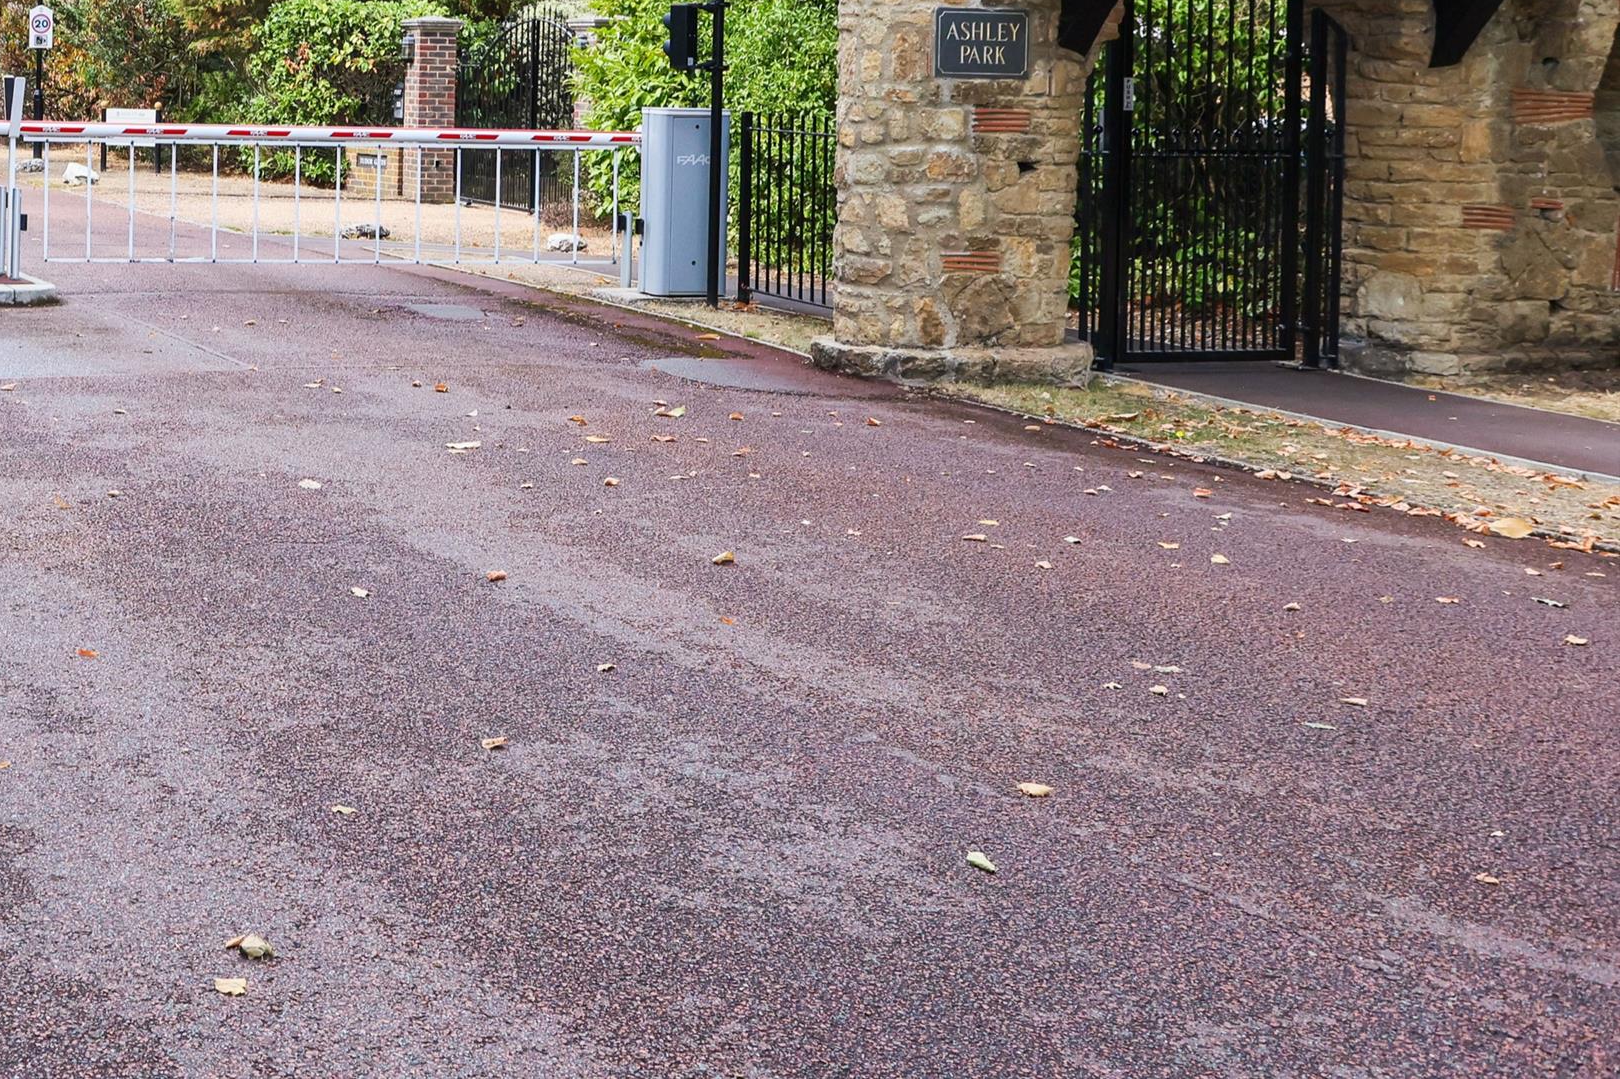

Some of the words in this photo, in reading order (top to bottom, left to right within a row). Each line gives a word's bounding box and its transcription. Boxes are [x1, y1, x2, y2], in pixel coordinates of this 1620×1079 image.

[34, 19, 49, 29] 20
[946, 20, 1020, 42] ASHLEY
[960, 44, 1006, 65] PARK
